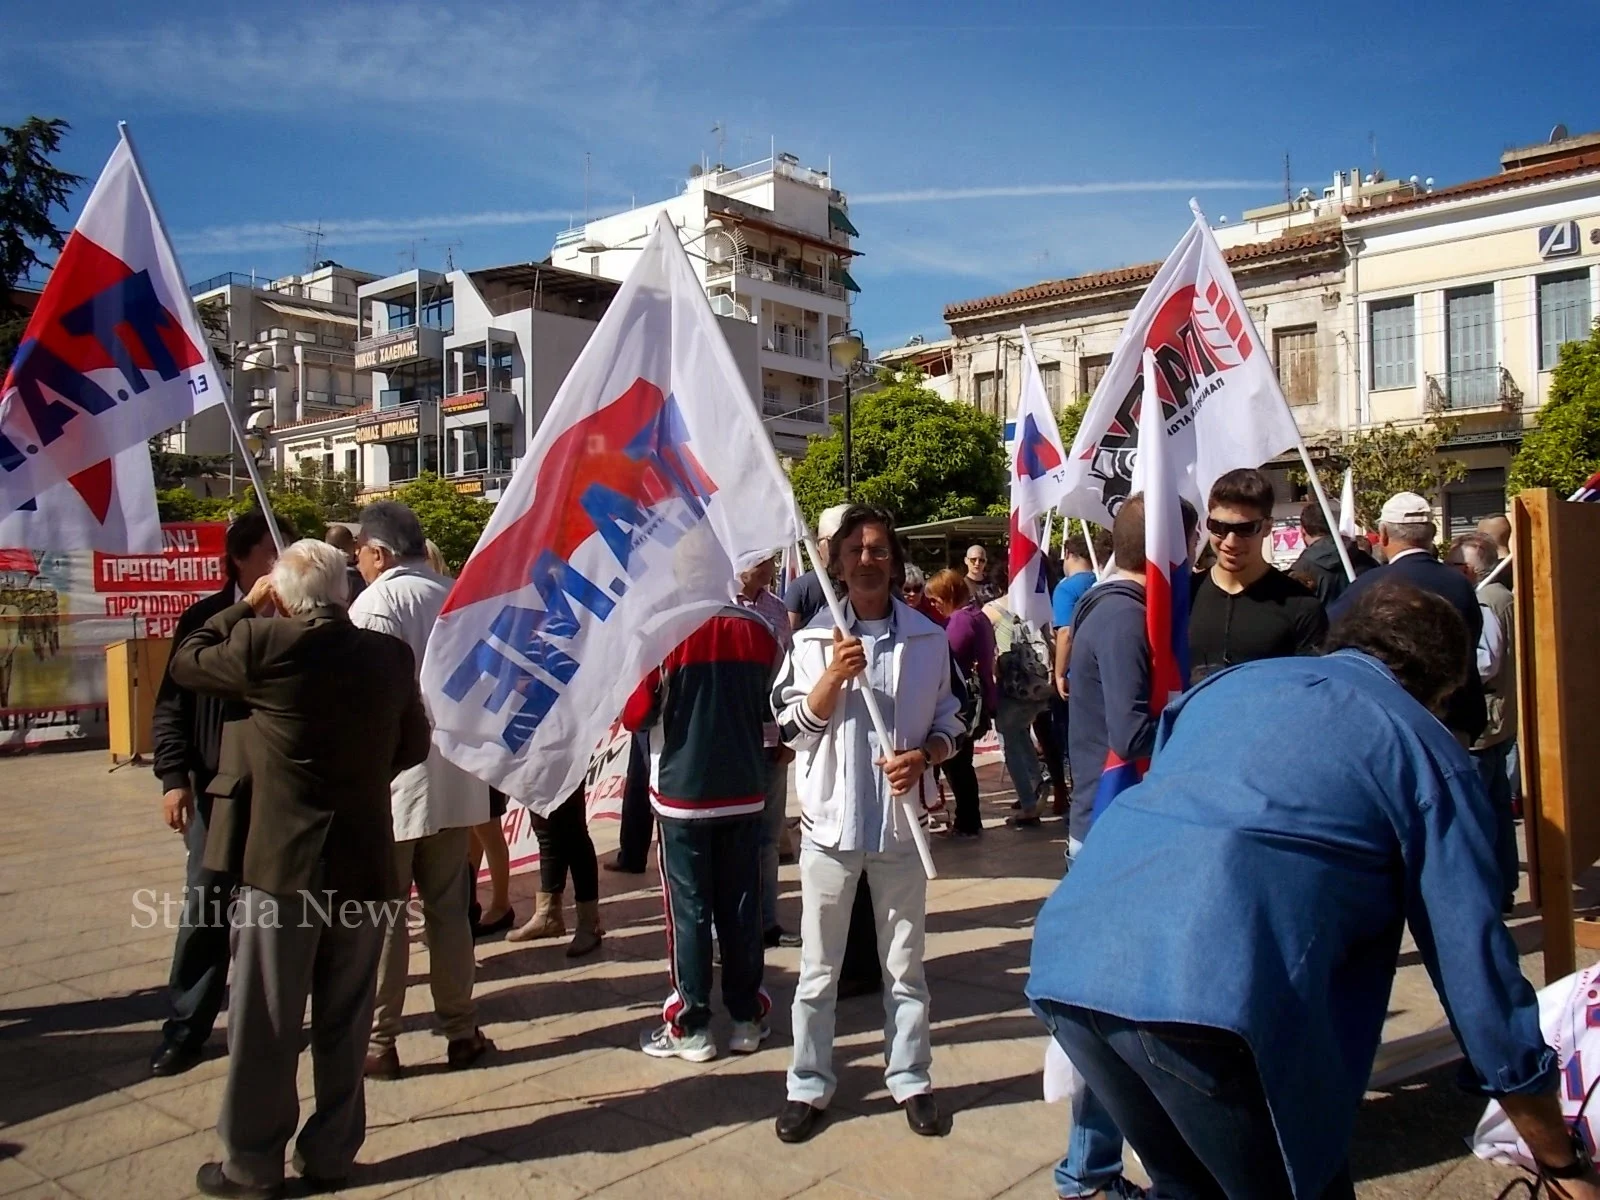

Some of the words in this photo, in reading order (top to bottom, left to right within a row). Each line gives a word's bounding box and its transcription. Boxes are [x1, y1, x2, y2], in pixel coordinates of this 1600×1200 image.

[354, 351, 377, 369] ΝΙΚΟΣ
[355, 424, 380, 443] ΘΩΜΑΣ
[381, 417, 419, 438] ΜΠΡΙΑΝΑΣ
[102, 556, 222, 583] ΠΡΩΤΟΜΑΓΙΑ
